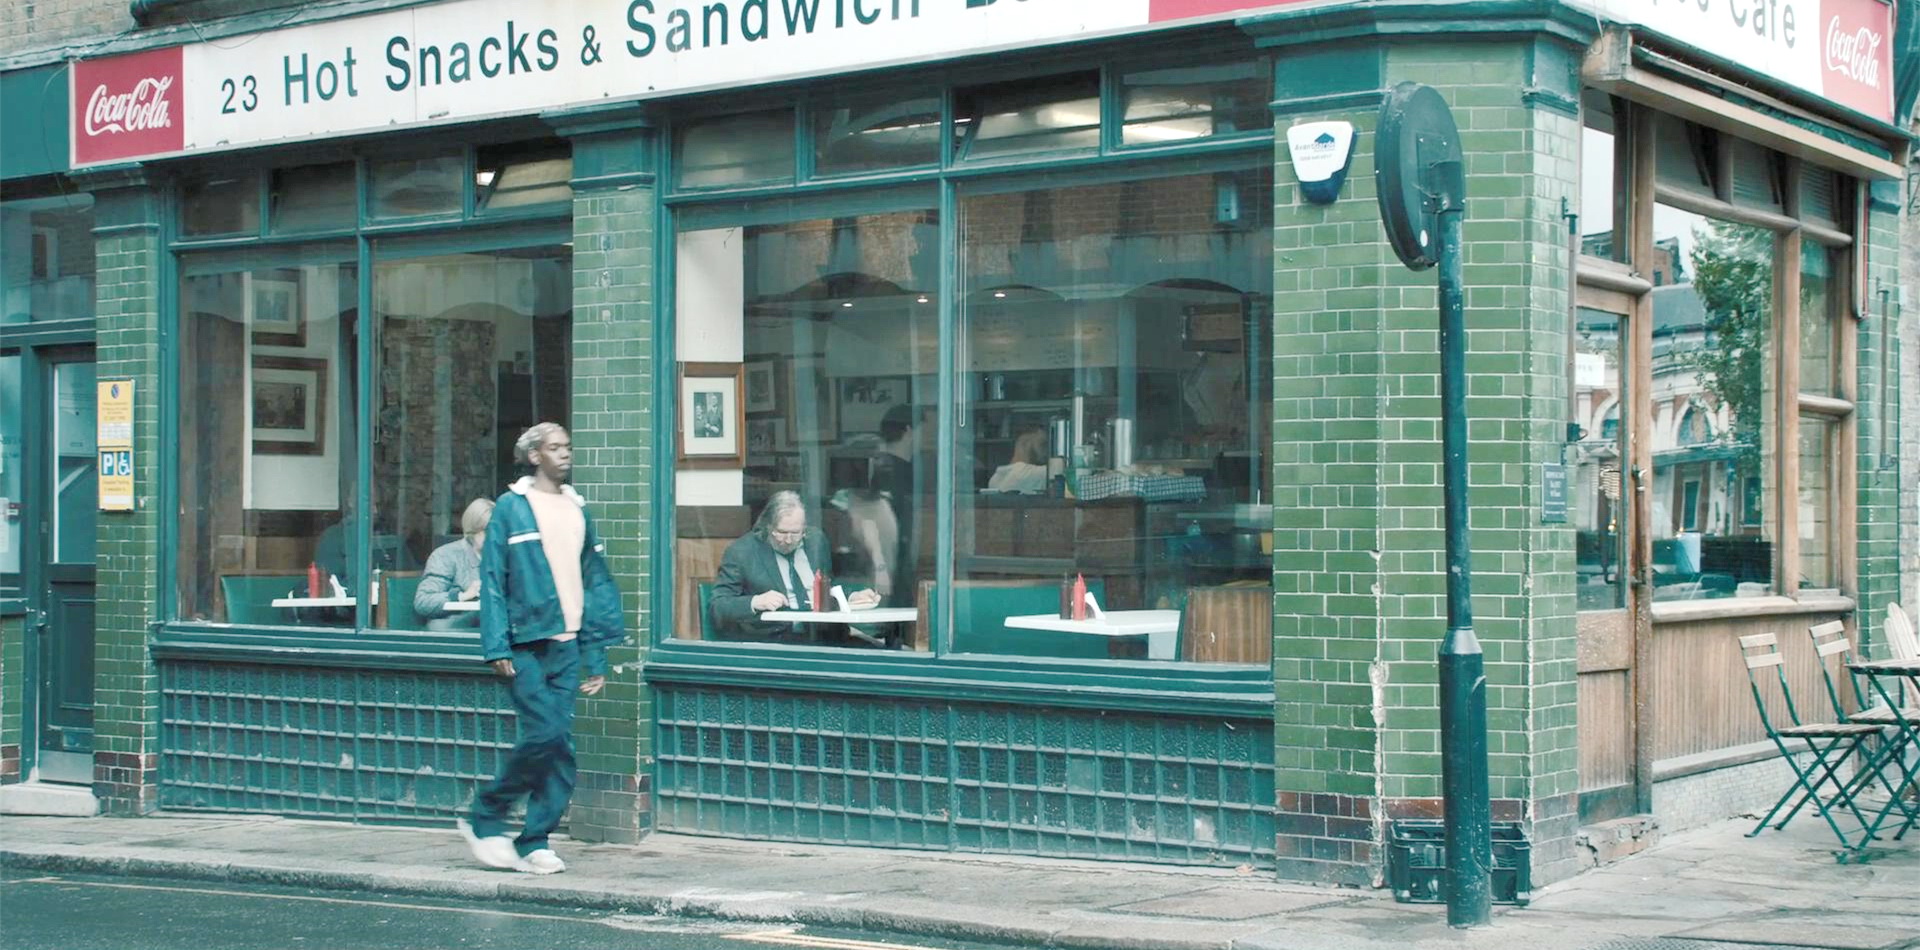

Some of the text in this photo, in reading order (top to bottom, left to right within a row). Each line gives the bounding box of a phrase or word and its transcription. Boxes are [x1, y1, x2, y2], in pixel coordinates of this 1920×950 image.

[221, 75, 258, 115] 23
[283, 47, 358, 106] Hot
[385, 20, 559, 92] Snacks
[580, 24, 604, 67] &
[1825, 14, 1882, 88] Coca-Cola
[84, 75, 174, 136] Coca-Cola
[103, 453, 114, 475] P
